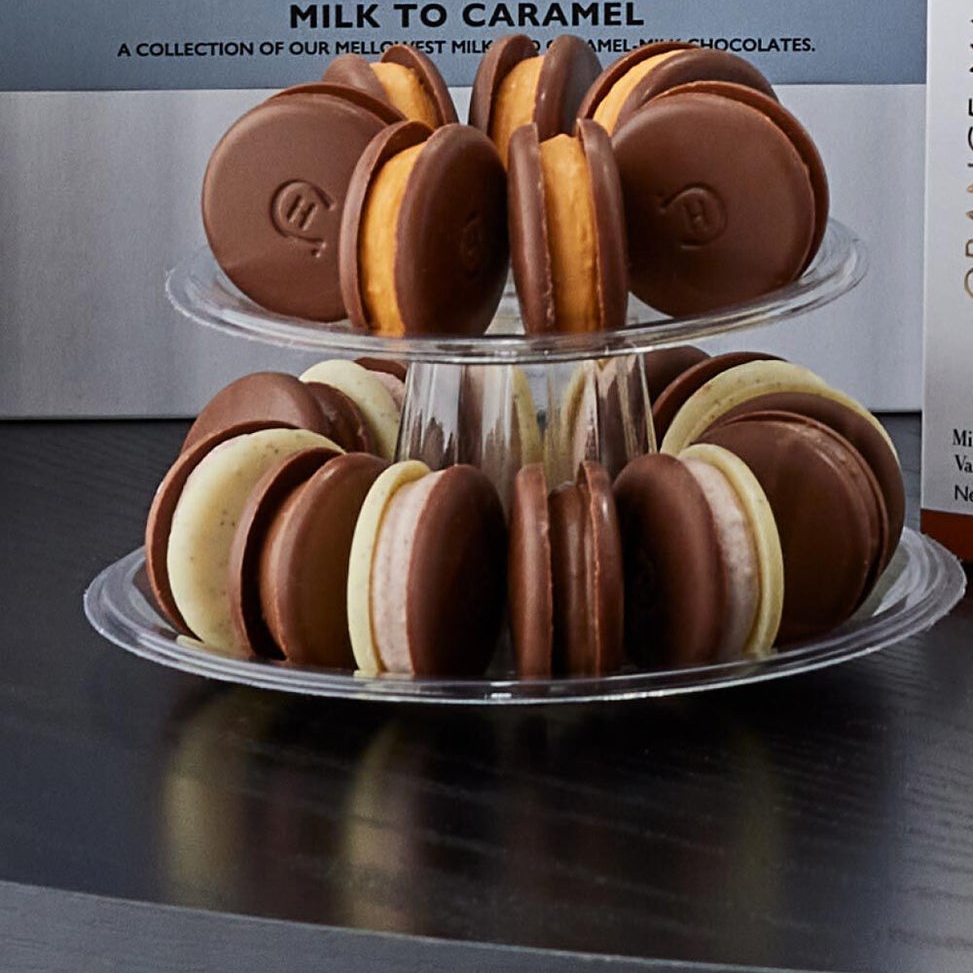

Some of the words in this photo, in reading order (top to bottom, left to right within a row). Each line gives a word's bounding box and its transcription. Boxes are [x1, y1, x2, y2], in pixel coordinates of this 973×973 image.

[290, 4, 380, 28] MILK
[393, 3, 448, 27] TO
[462, 2, 645, 27] CARAMEL
[117, 43, 131, 57] A
[136, 42, 254, 57] COLLECTION
[259, 42, 284, 56] OF
[289, 41, 330, 55] OUR
[451, 40, 493, 54] MILK
